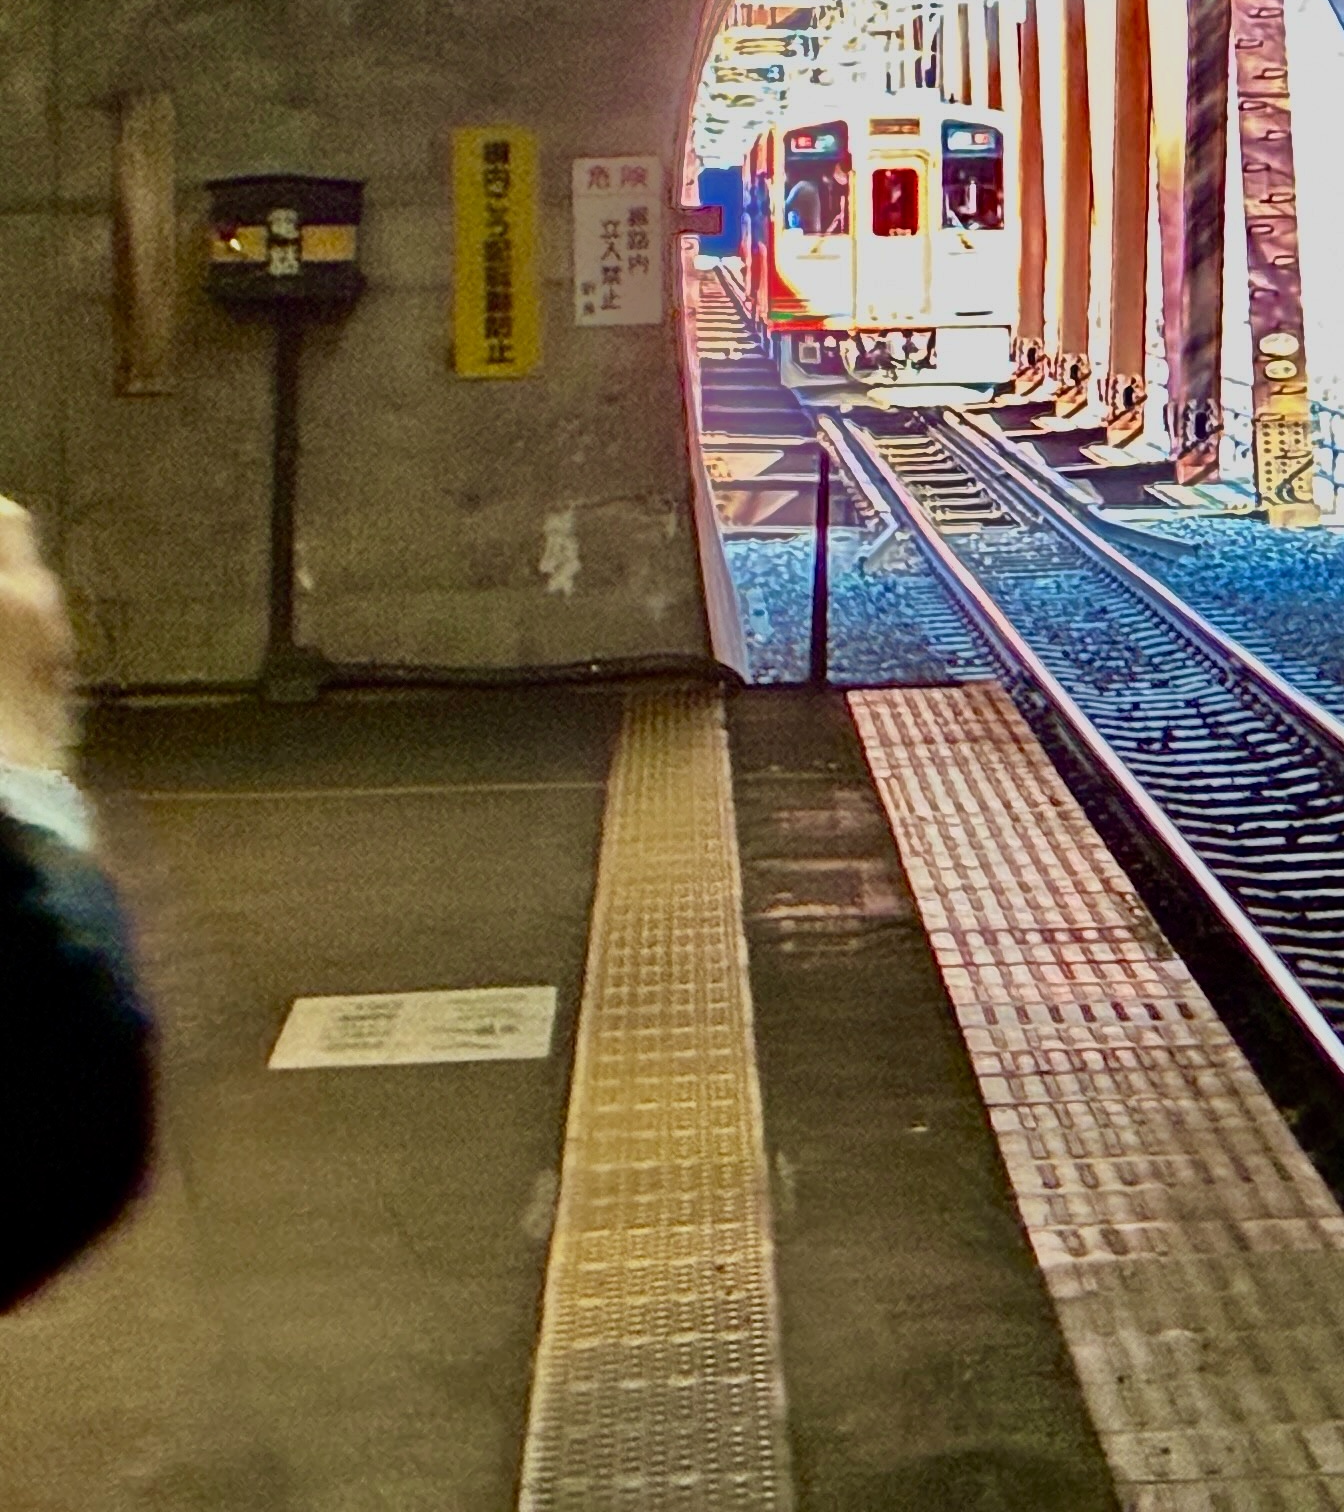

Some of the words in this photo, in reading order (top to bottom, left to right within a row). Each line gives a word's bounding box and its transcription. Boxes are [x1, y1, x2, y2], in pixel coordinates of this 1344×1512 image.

[587, 164, 648, 190] 危険
[600, 219, 622, 310] 立入禁止
[627, 205, 650, 275] 線路内
